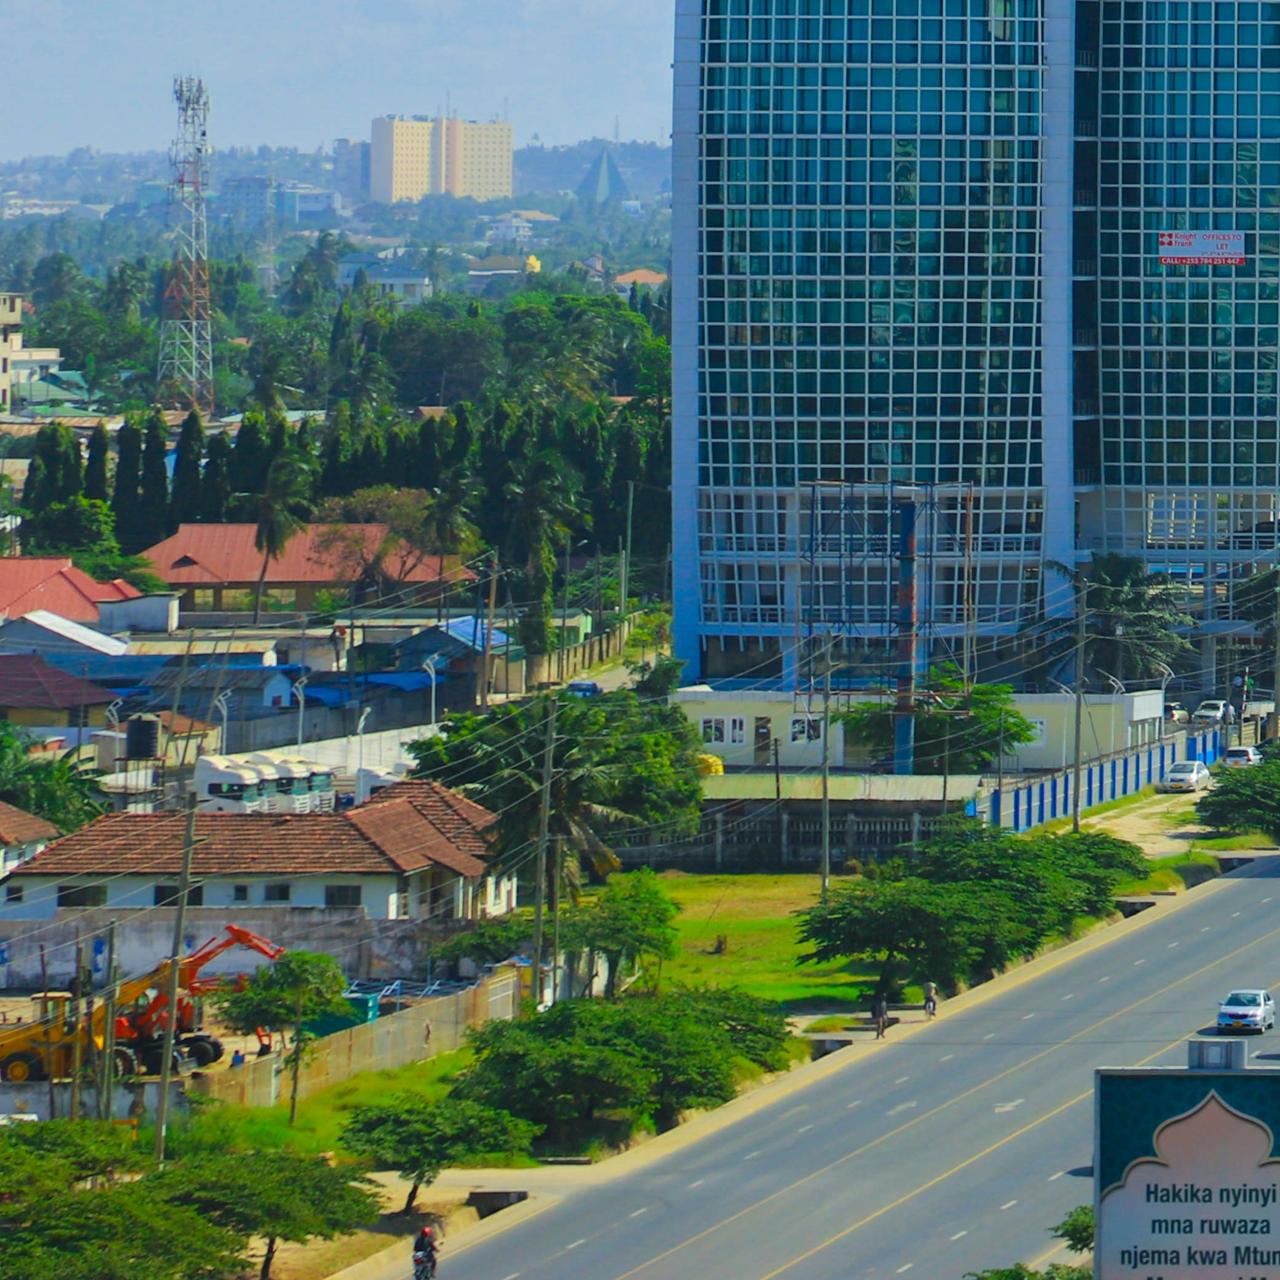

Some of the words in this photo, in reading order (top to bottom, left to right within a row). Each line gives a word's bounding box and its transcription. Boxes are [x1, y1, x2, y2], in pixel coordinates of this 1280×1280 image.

[1146, 1184, 1212, 1203] Hakika
[1219, 1184, 1277, 1207] nyinyi
[1151, 1219, 1193, 1234] mna
[1200, 1219, 1271, 1234] ruwaza
[1120, 1246, 1180, 1269] njema
[1187, 1246, 1227, 1265] kwa
